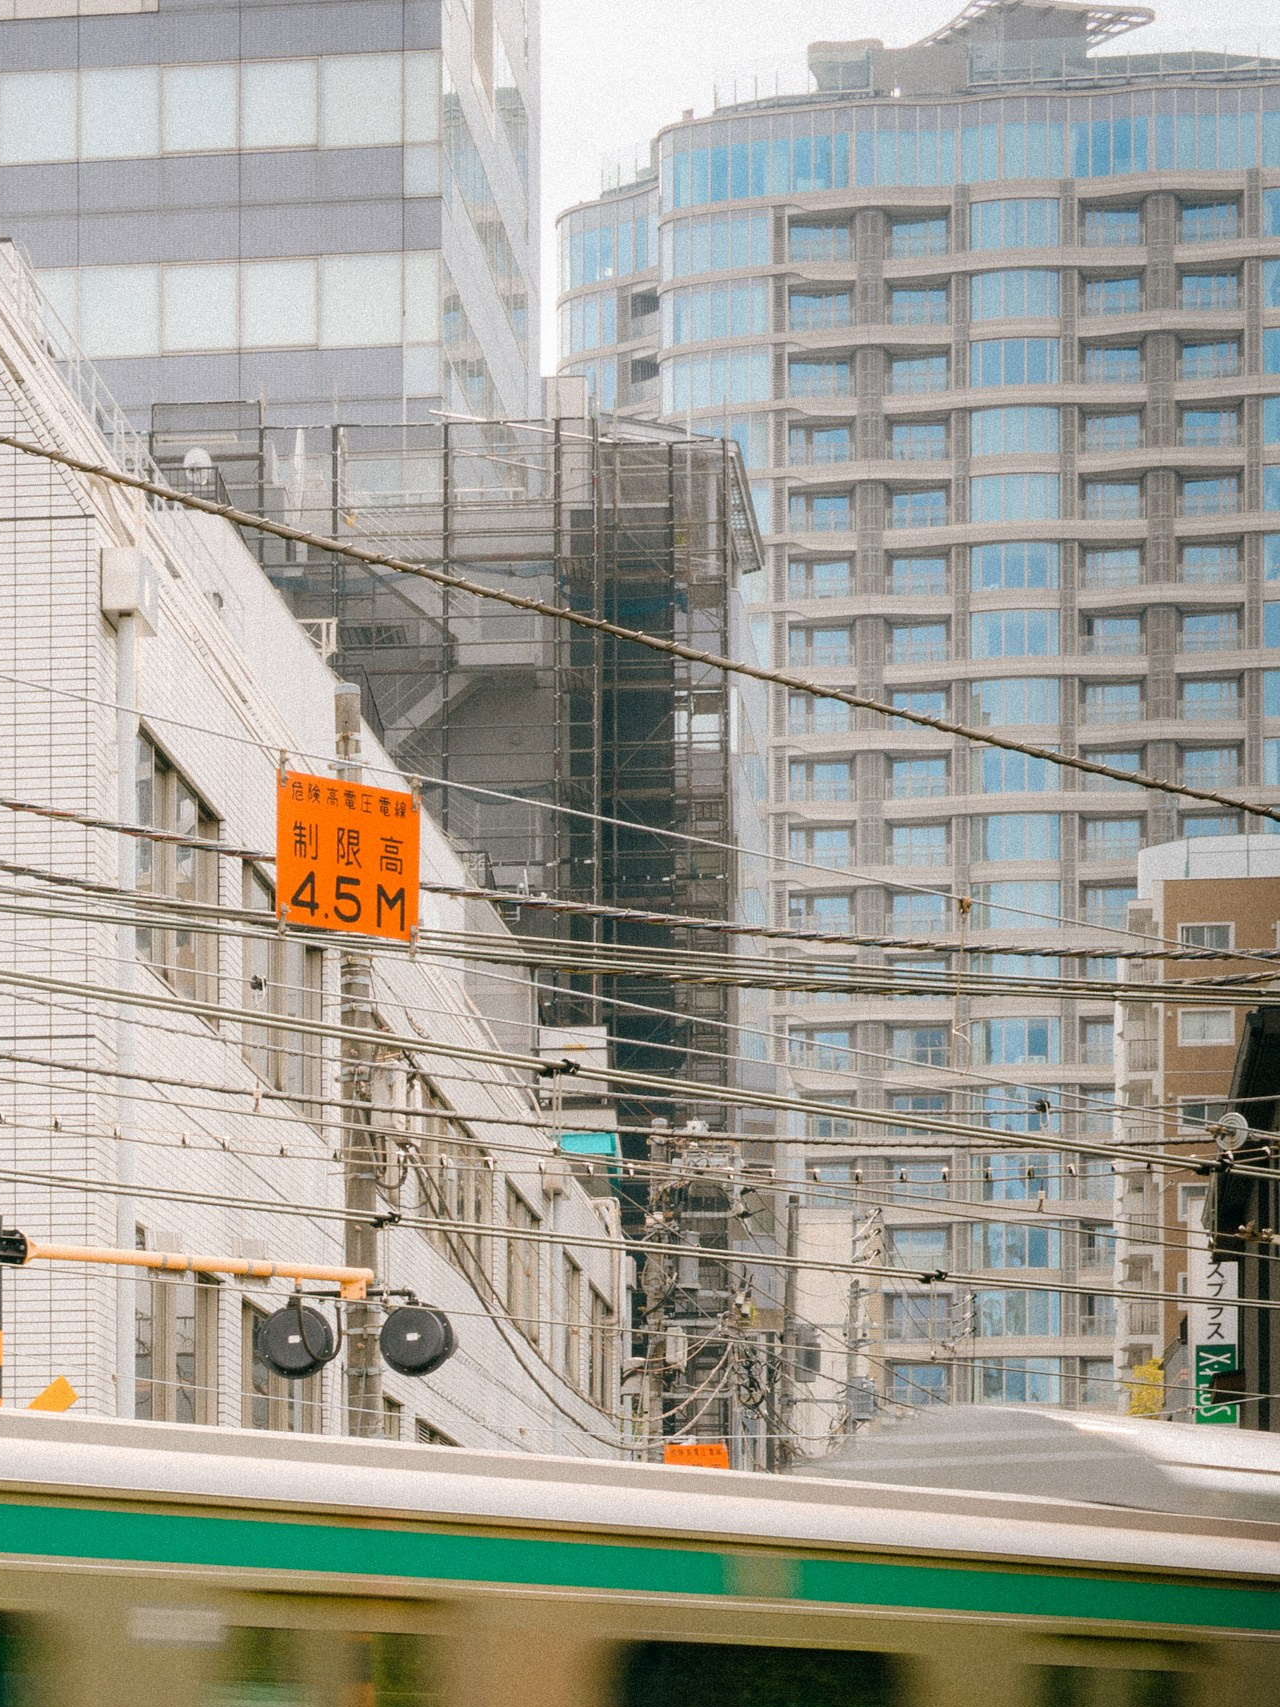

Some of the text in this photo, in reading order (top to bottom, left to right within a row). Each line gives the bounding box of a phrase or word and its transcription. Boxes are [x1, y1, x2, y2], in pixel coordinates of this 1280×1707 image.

[291, 781, 407, 820] 危険高電圧電線
[293, 820, 404, 876] 制限高
[290, 870, 406, 932] 4.5M
